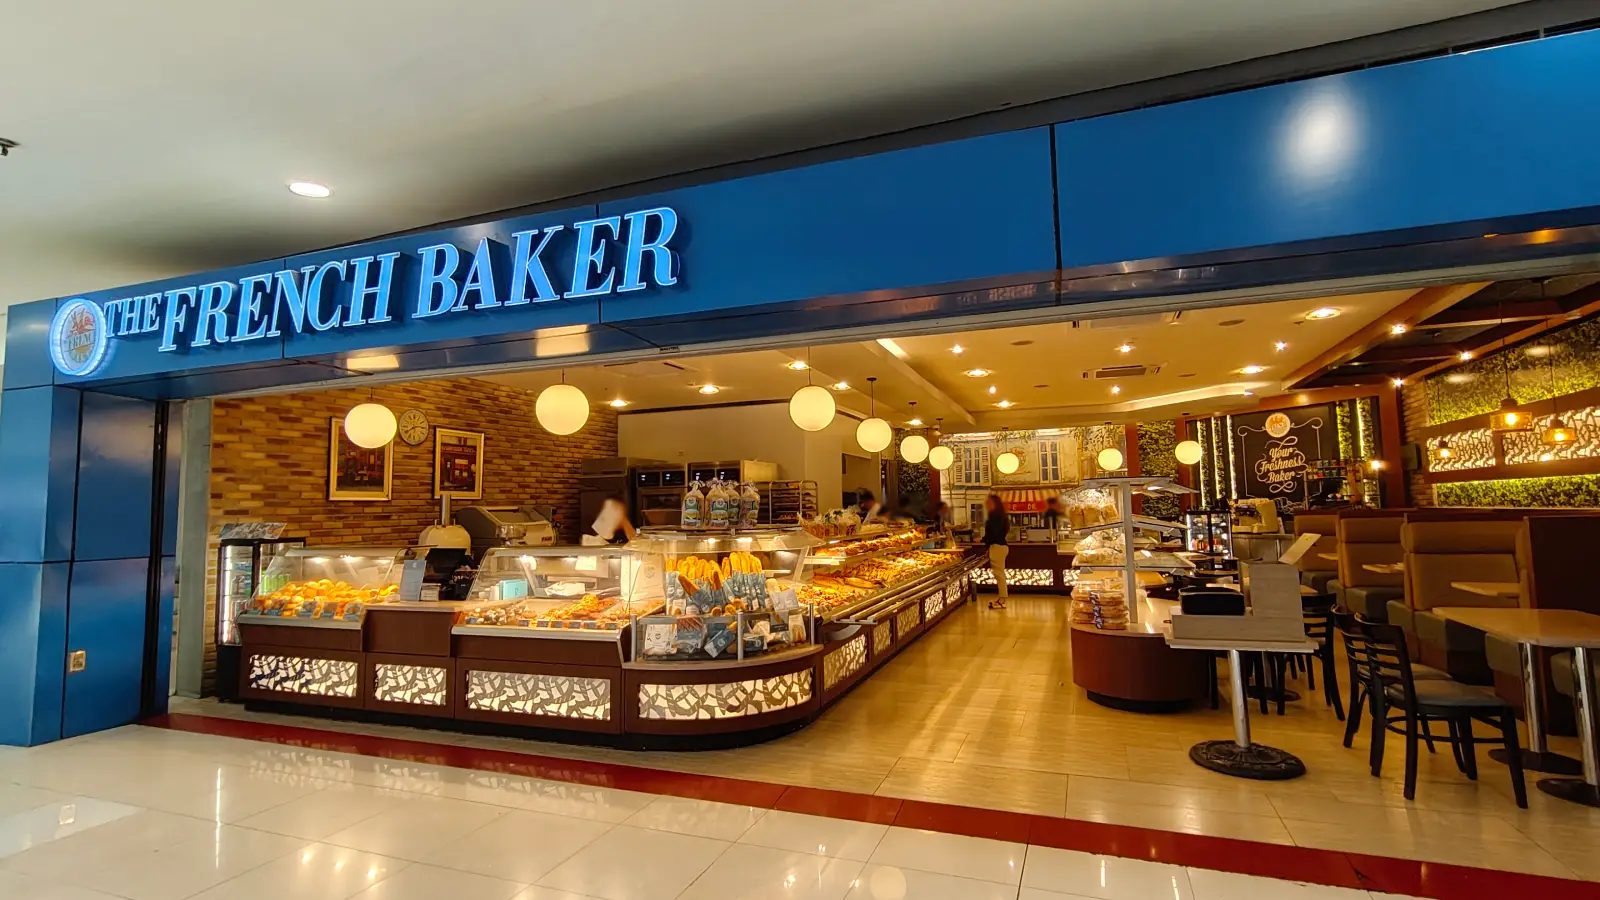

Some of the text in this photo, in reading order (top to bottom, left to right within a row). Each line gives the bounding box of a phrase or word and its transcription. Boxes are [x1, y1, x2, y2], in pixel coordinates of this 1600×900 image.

[103, 206, 679, 352] THE FRENCH BAKER
[1269, 447, 1293, 462] Your
[1260, 456, 1302, 473] Freshness
[1267, 470, 1295, 483] Baker
